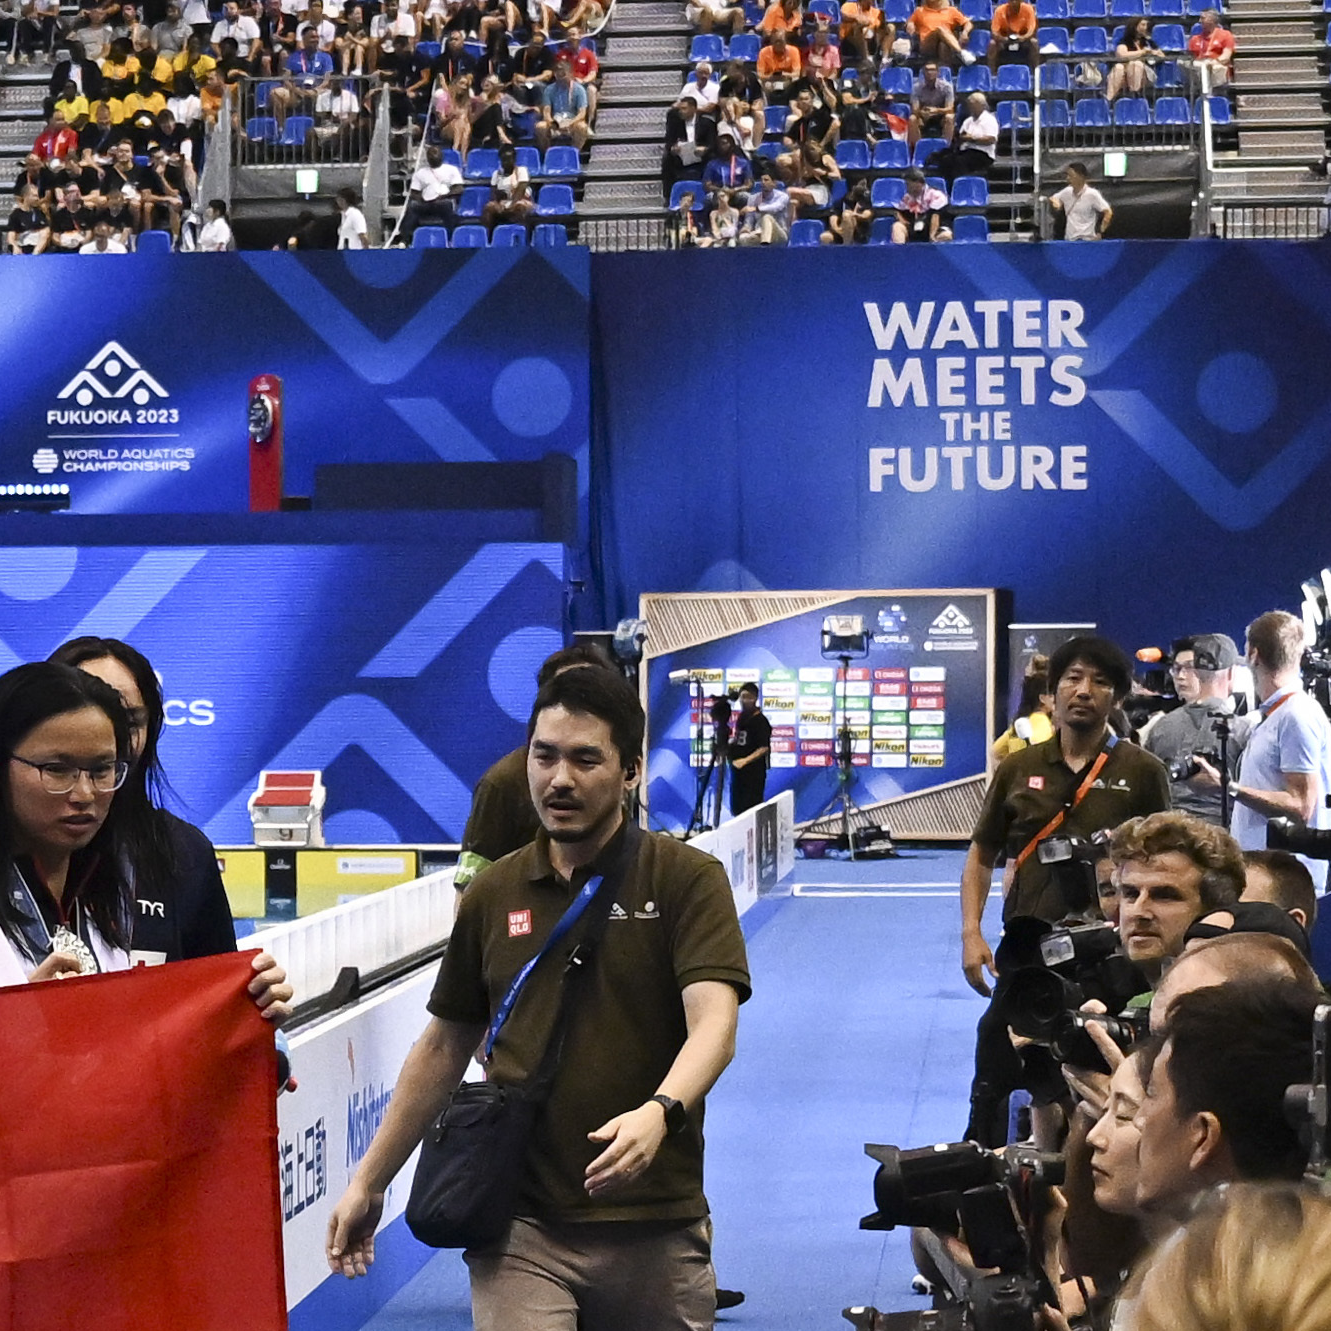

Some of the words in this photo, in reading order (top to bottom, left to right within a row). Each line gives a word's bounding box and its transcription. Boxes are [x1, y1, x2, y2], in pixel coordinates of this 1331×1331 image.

[863, 299, 1088, 350] WATER
[866, 355, 1087, 408] MEETS
[47, 409, 133, 425] FUKUOKA
[136, 409, 180, 424] 2023
[939, 411, 1012, 441] THE
[63, 449, 119, 461] WORLD
[121, 448, 196, 460] AQUATICS
[62, 461, 191, 473] CHAMPIONSHIPS
[869, 445, 1088, 492] FUTURE
[764, 699, 795, 708] Nikon
[801, 713, 831, 722] Nikon
[874, 742, 905, 751] Nikon
[910, 756, 942, 765] Nikon
[136, 899, 166, 918] TYR
[509, 912, 528, 923] UNI
[509, 922, 529, 934] QLO
[278, 1117, 328, 1223] 海上日動
